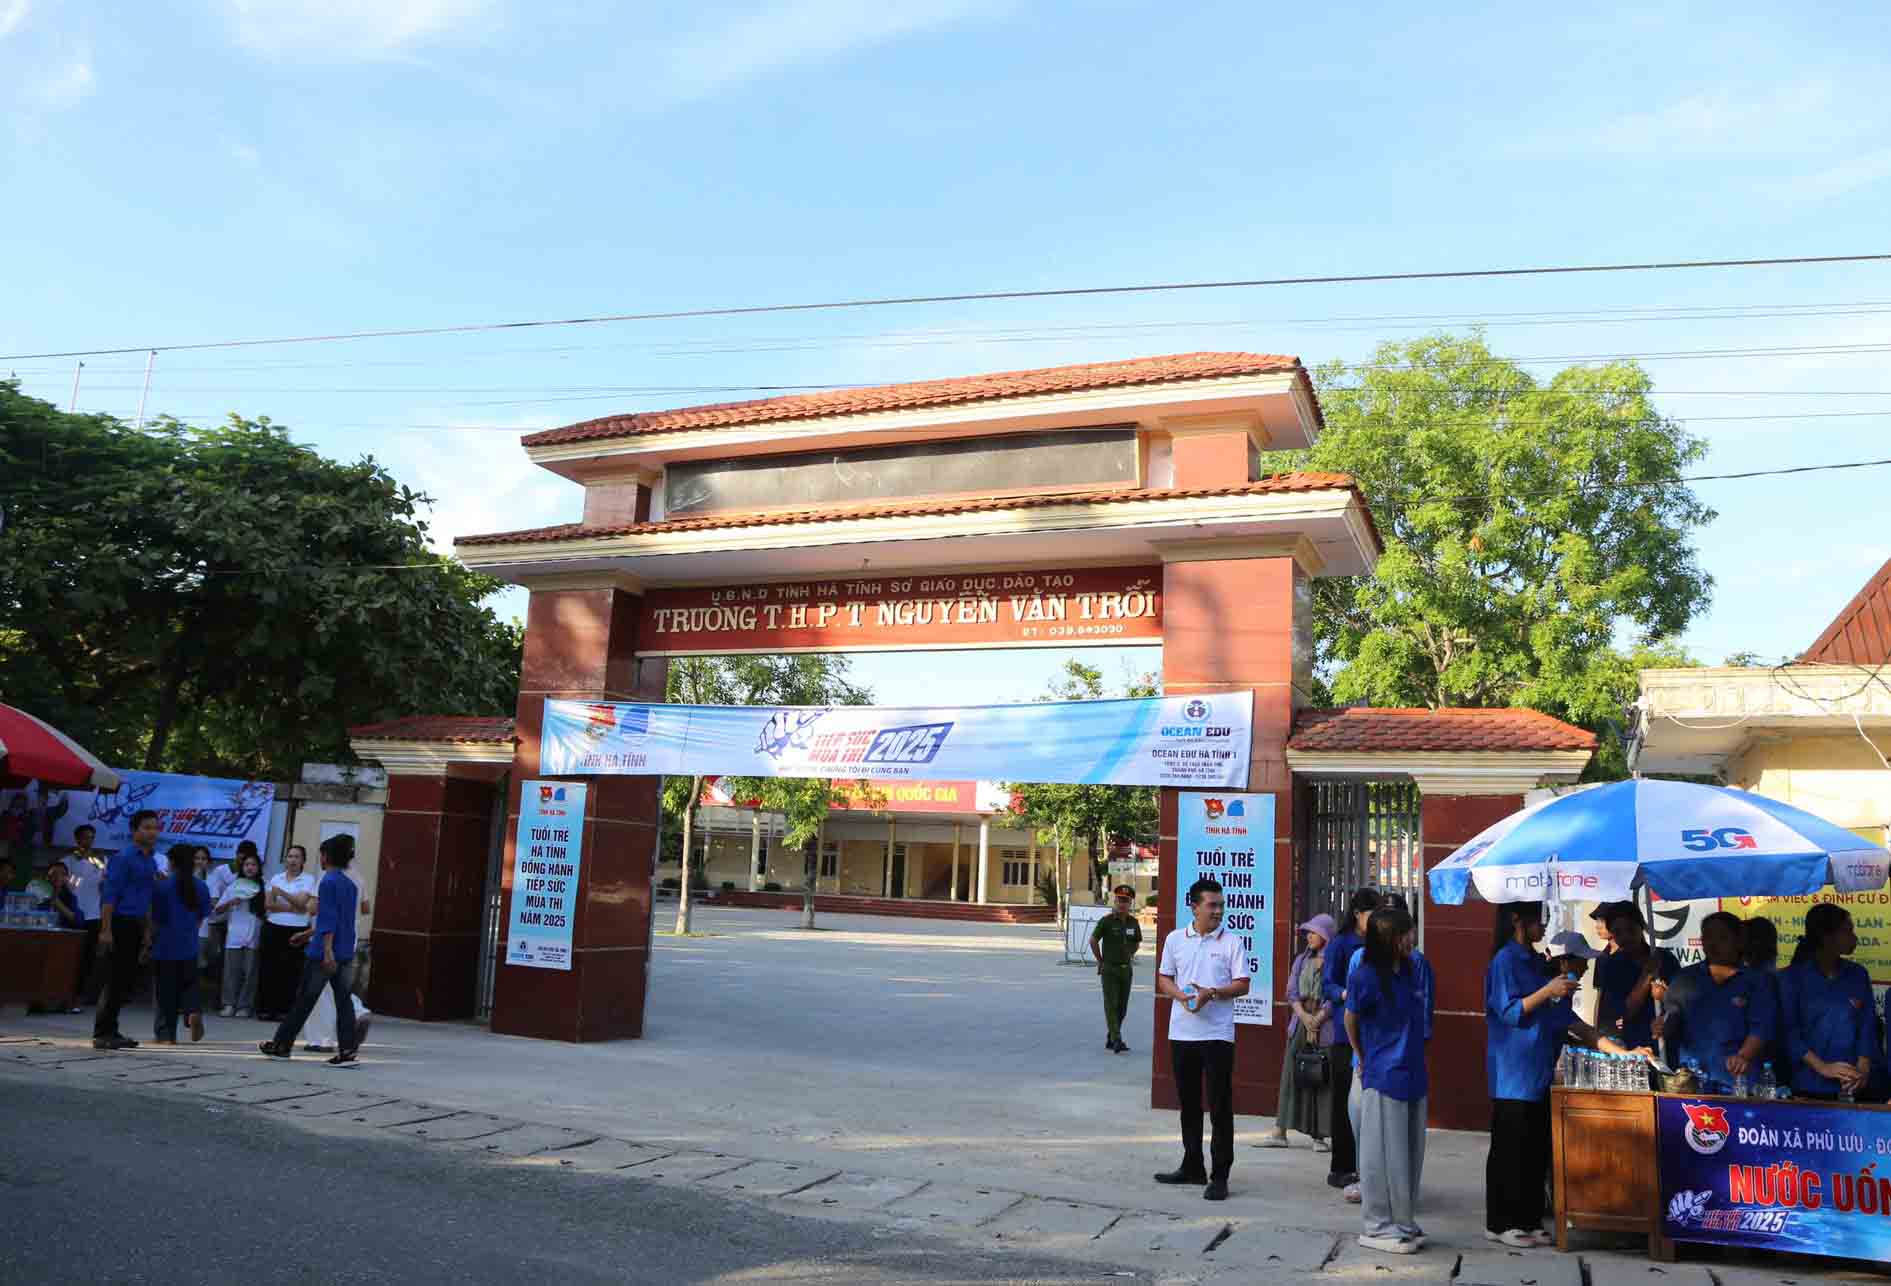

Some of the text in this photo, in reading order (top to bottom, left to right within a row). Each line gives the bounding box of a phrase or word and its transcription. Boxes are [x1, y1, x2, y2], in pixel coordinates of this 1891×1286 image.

[877, 590, 1000, 627] NGUYỄN
[1009, 586, 1068, 622] VĂN
[1161, 727, 1231, 737] OCEAN EDU
[1152, 749, 1179, 758] OCEAN
[1680, 827, 1759, 851] 5G
[1196, 846, 1255, 868] TUỔI TRẺ
[1221, 870, 1252, 889] TĨNH
[1505, 870, 1600, 889] mobfone
[1227, 891, 1265, 910] HÀNH
[543, 914, 566, 927] 2025
[1227, 911, 1255, 930] SỨC
[1738, 1124, 1779, 1147] ĐOÀN
[1783, 1128, 1803, 1149] XÃ
[1807, 1130, 1834, 1151] PHÙ
[1839, 1134, 1864, 1153] LƯU
[1729, 1160, 1823, 1211] NƯỚC
[1741, 1211, 1787, 1232] 2025
